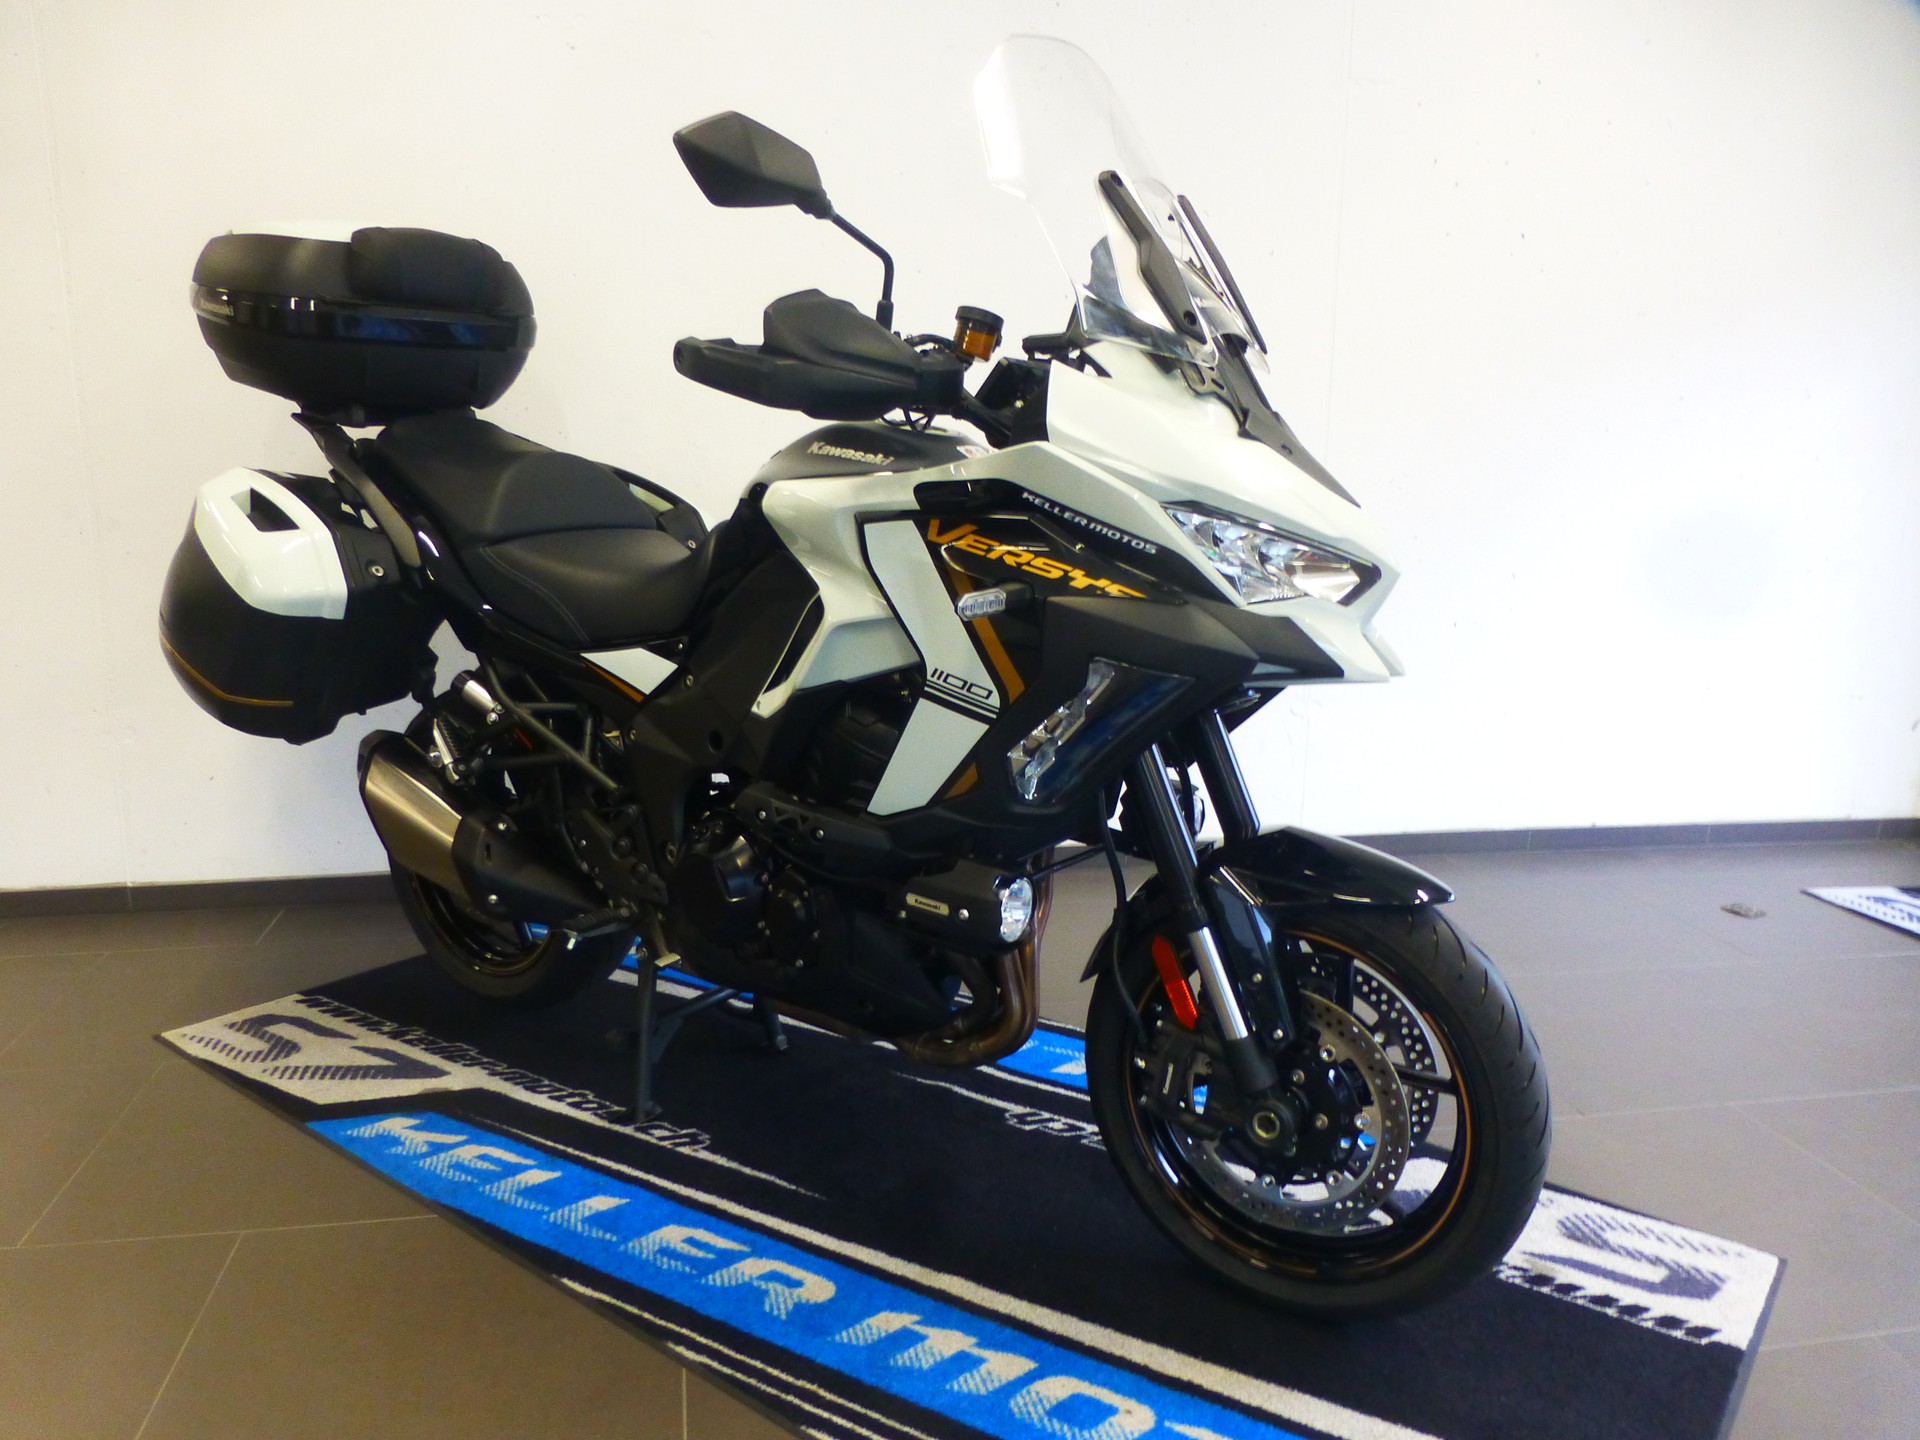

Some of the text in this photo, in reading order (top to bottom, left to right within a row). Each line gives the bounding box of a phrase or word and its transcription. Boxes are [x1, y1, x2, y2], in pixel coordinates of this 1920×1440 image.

[806, 441, 895, 466] Kawasaki
[1022, 491, 1088, 526] KELLER
[930, 667, 993, 700] 1100
[340, 1116, 837, 1321] KELLER
